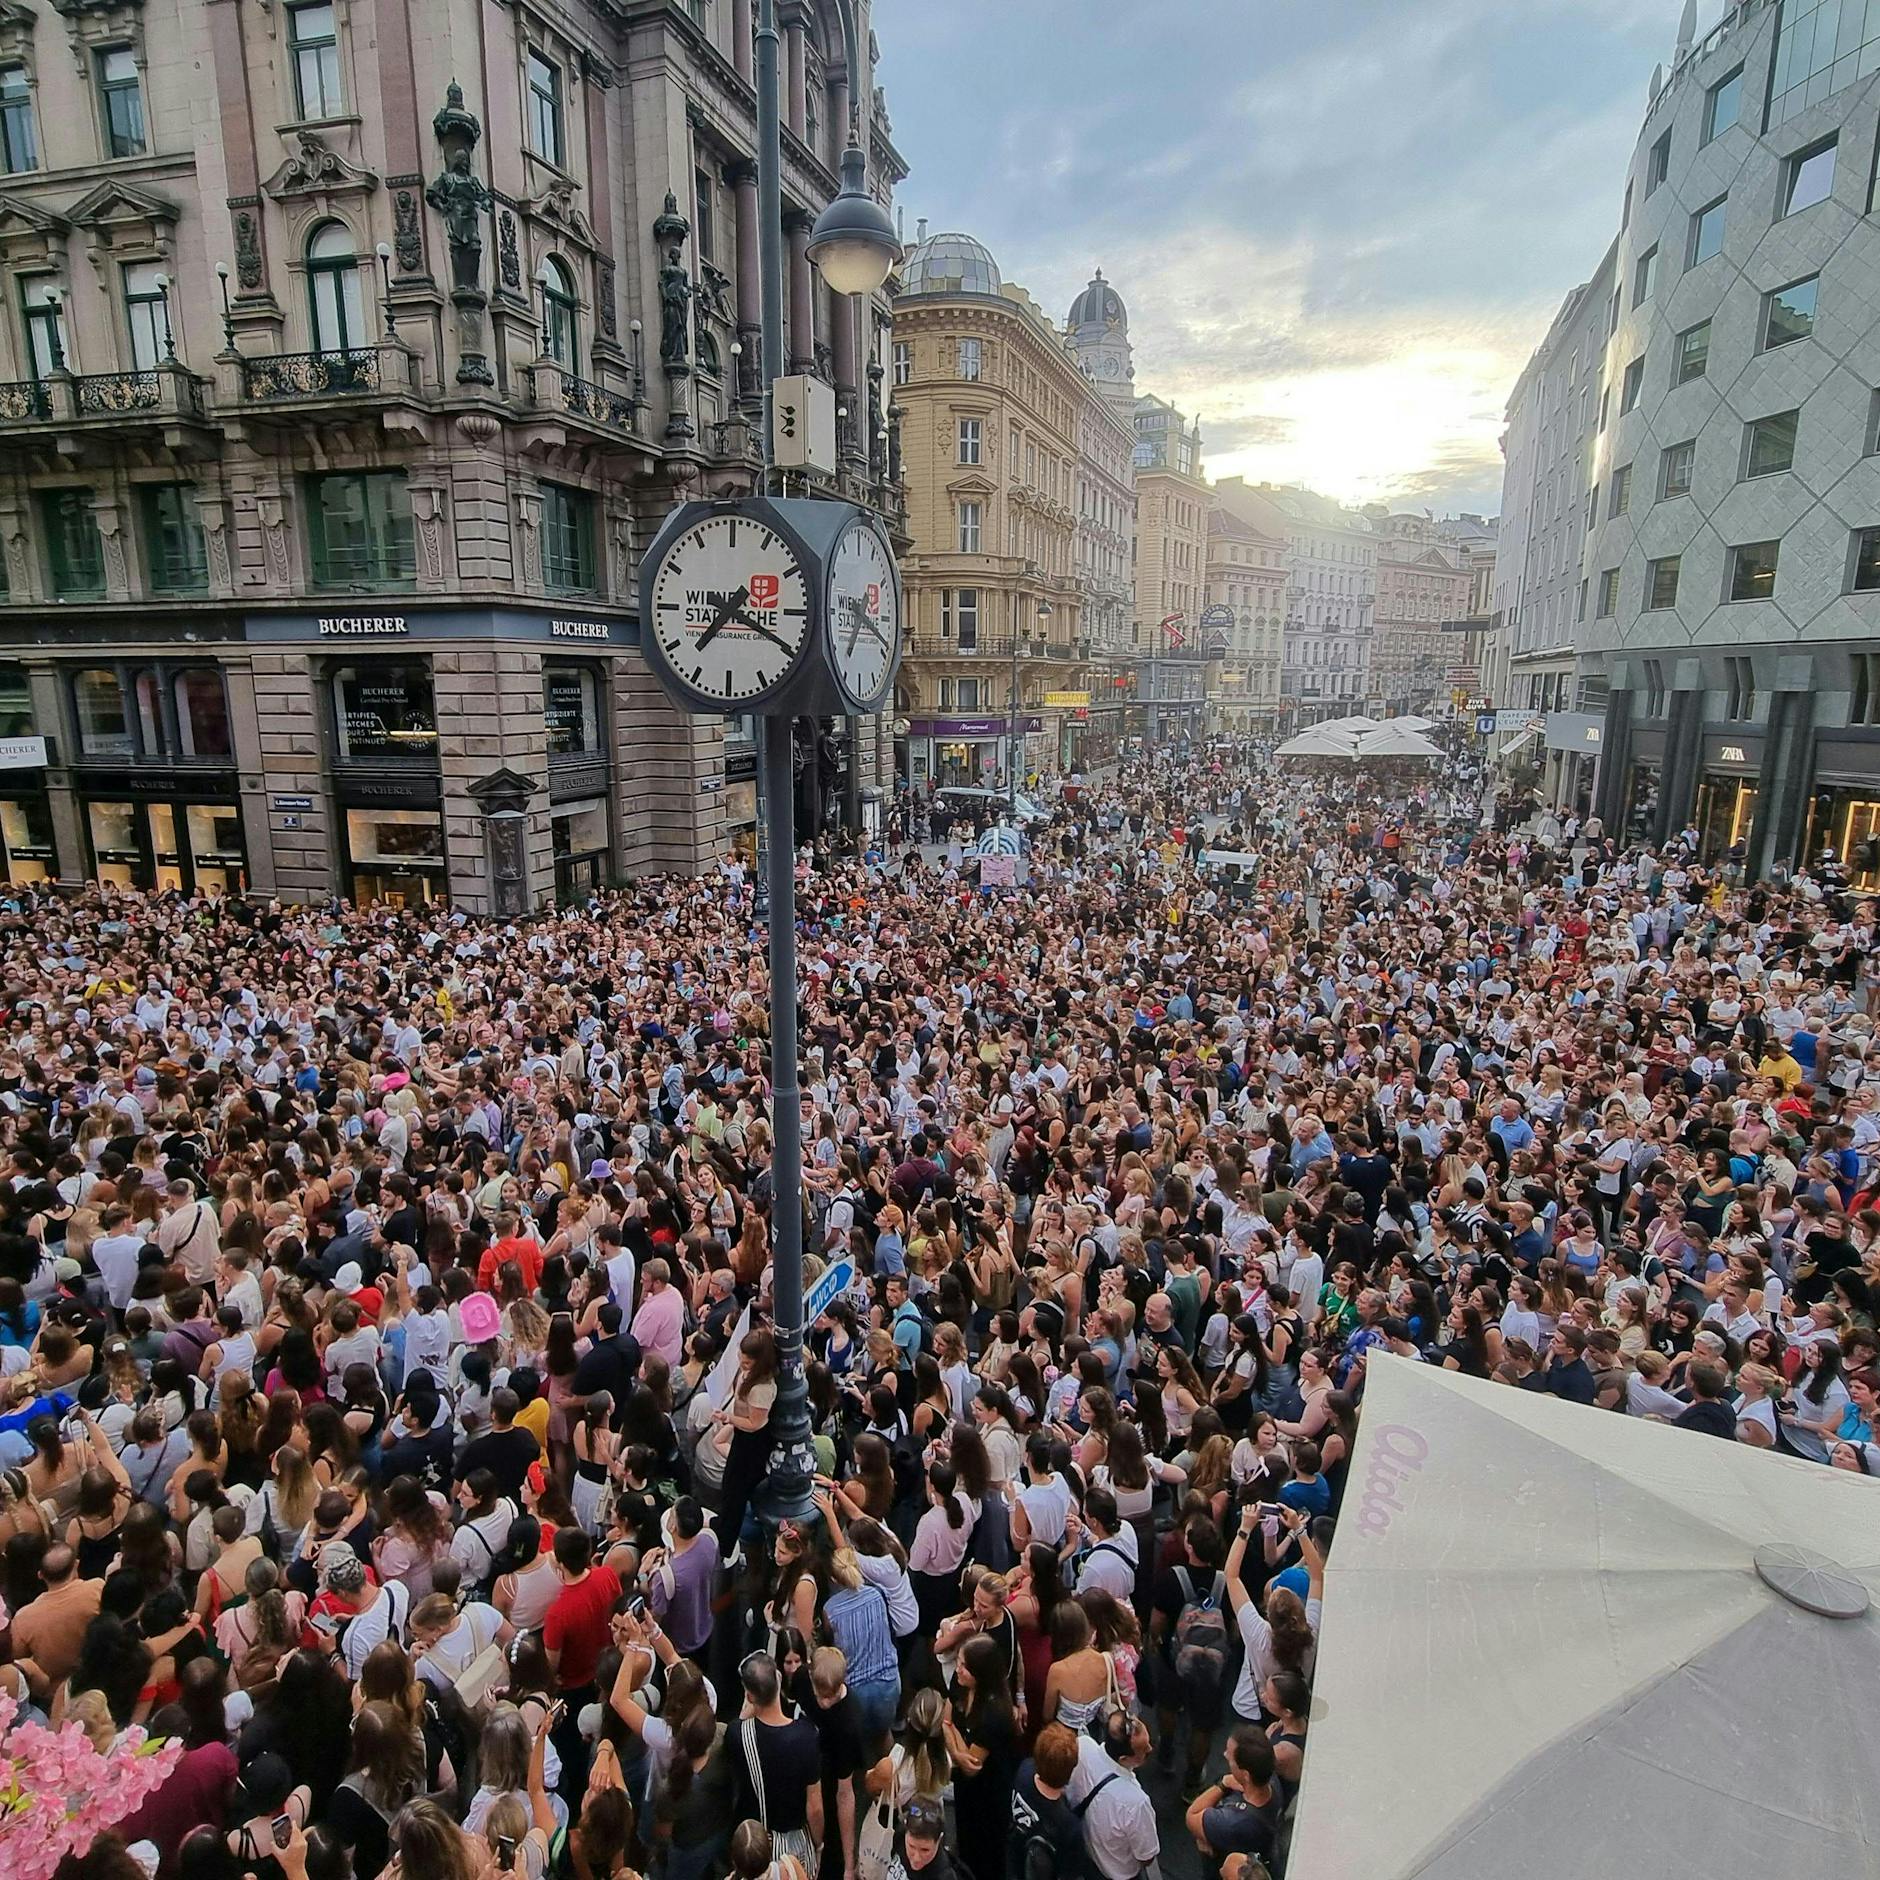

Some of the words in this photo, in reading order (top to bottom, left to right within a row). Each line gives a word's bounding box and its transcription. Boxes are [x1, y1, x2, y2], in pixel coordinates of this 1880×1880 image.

[685, 608, 778, 626] STÄDCHE
[318, 617, 408, 634] BUCHERER
[552, 620, 609, 639] BUCHERER
[362, 687, 405, 696] BUCHERER
[1479, 719, 1494, 733] U
[1721, 746, 1746, 761] ZARA
